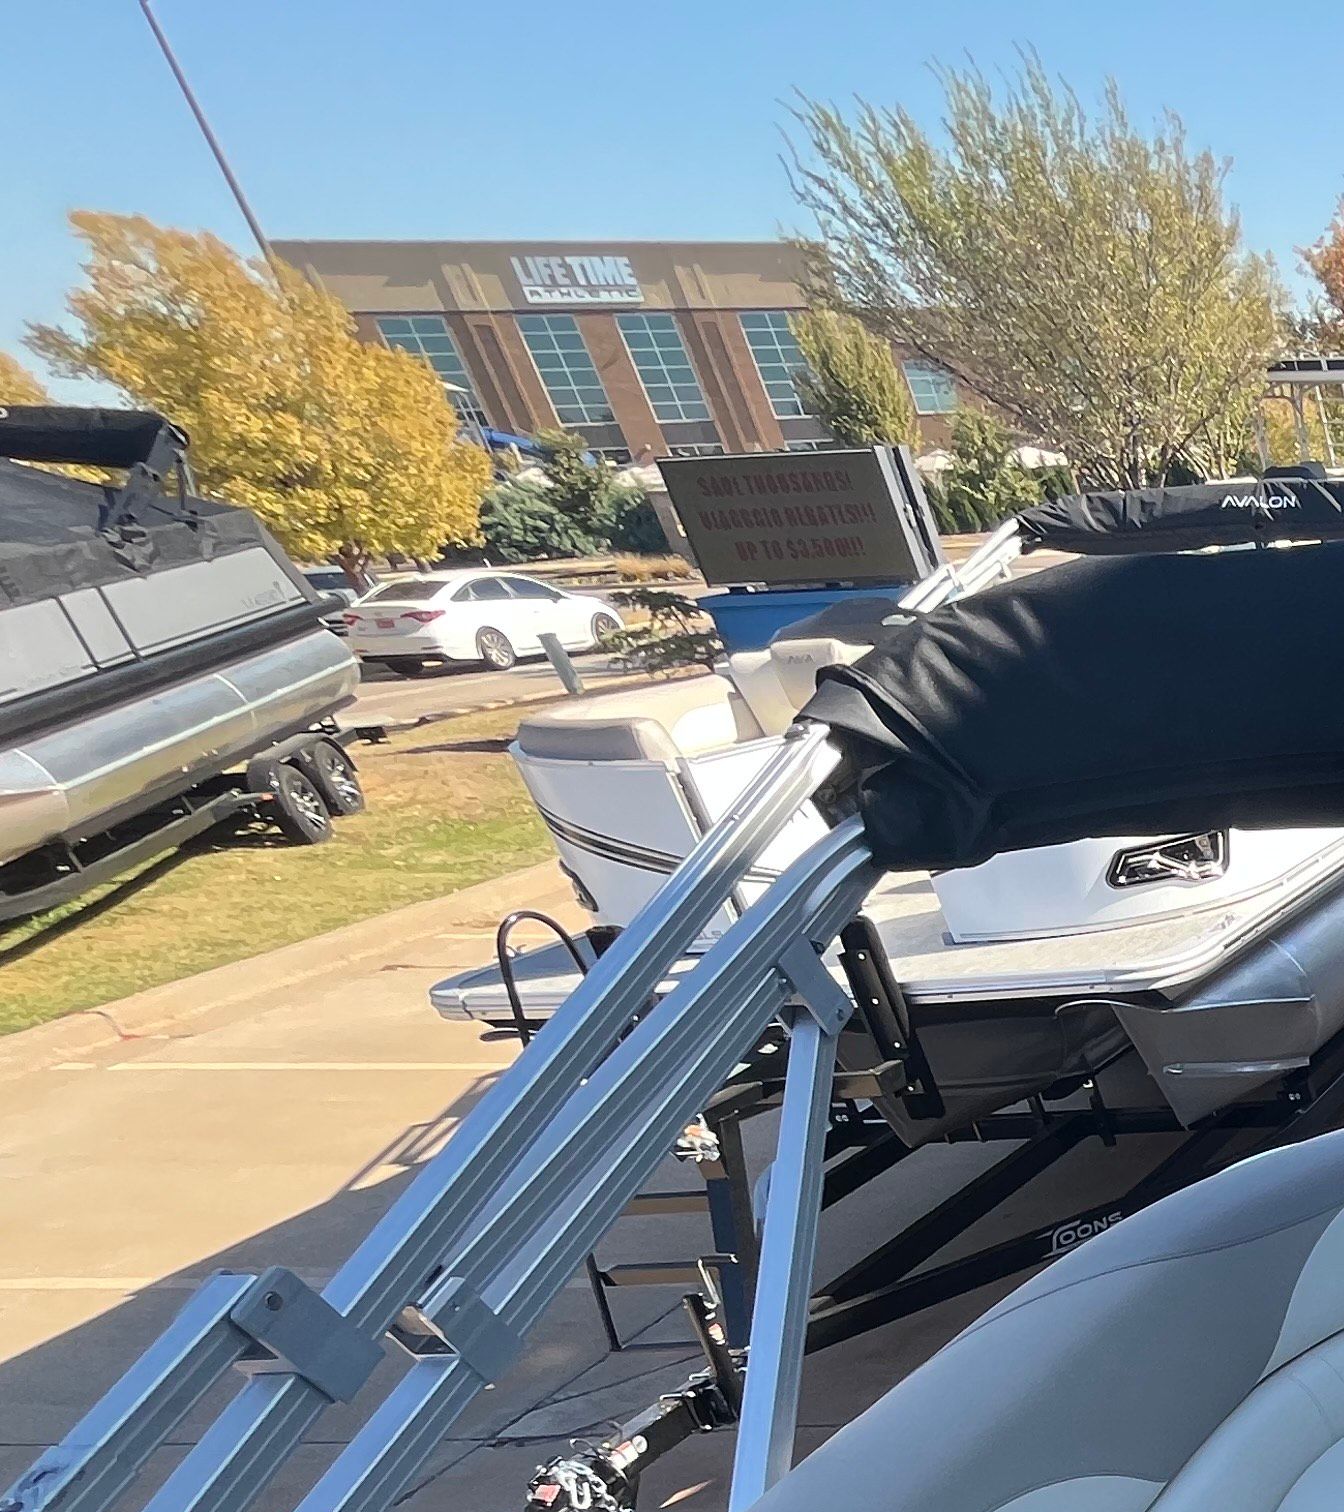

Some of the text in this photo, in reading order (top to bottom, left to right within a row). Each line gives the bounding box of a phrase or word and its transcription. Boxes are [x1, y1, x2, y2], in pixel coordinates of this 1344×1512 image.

[510, 256, 638, 286] LIFE TIME
[1221, 495, 1296, 508] AVALON
[735, 541, 757, 562] UP
[762, 539, 783, 561] TO
